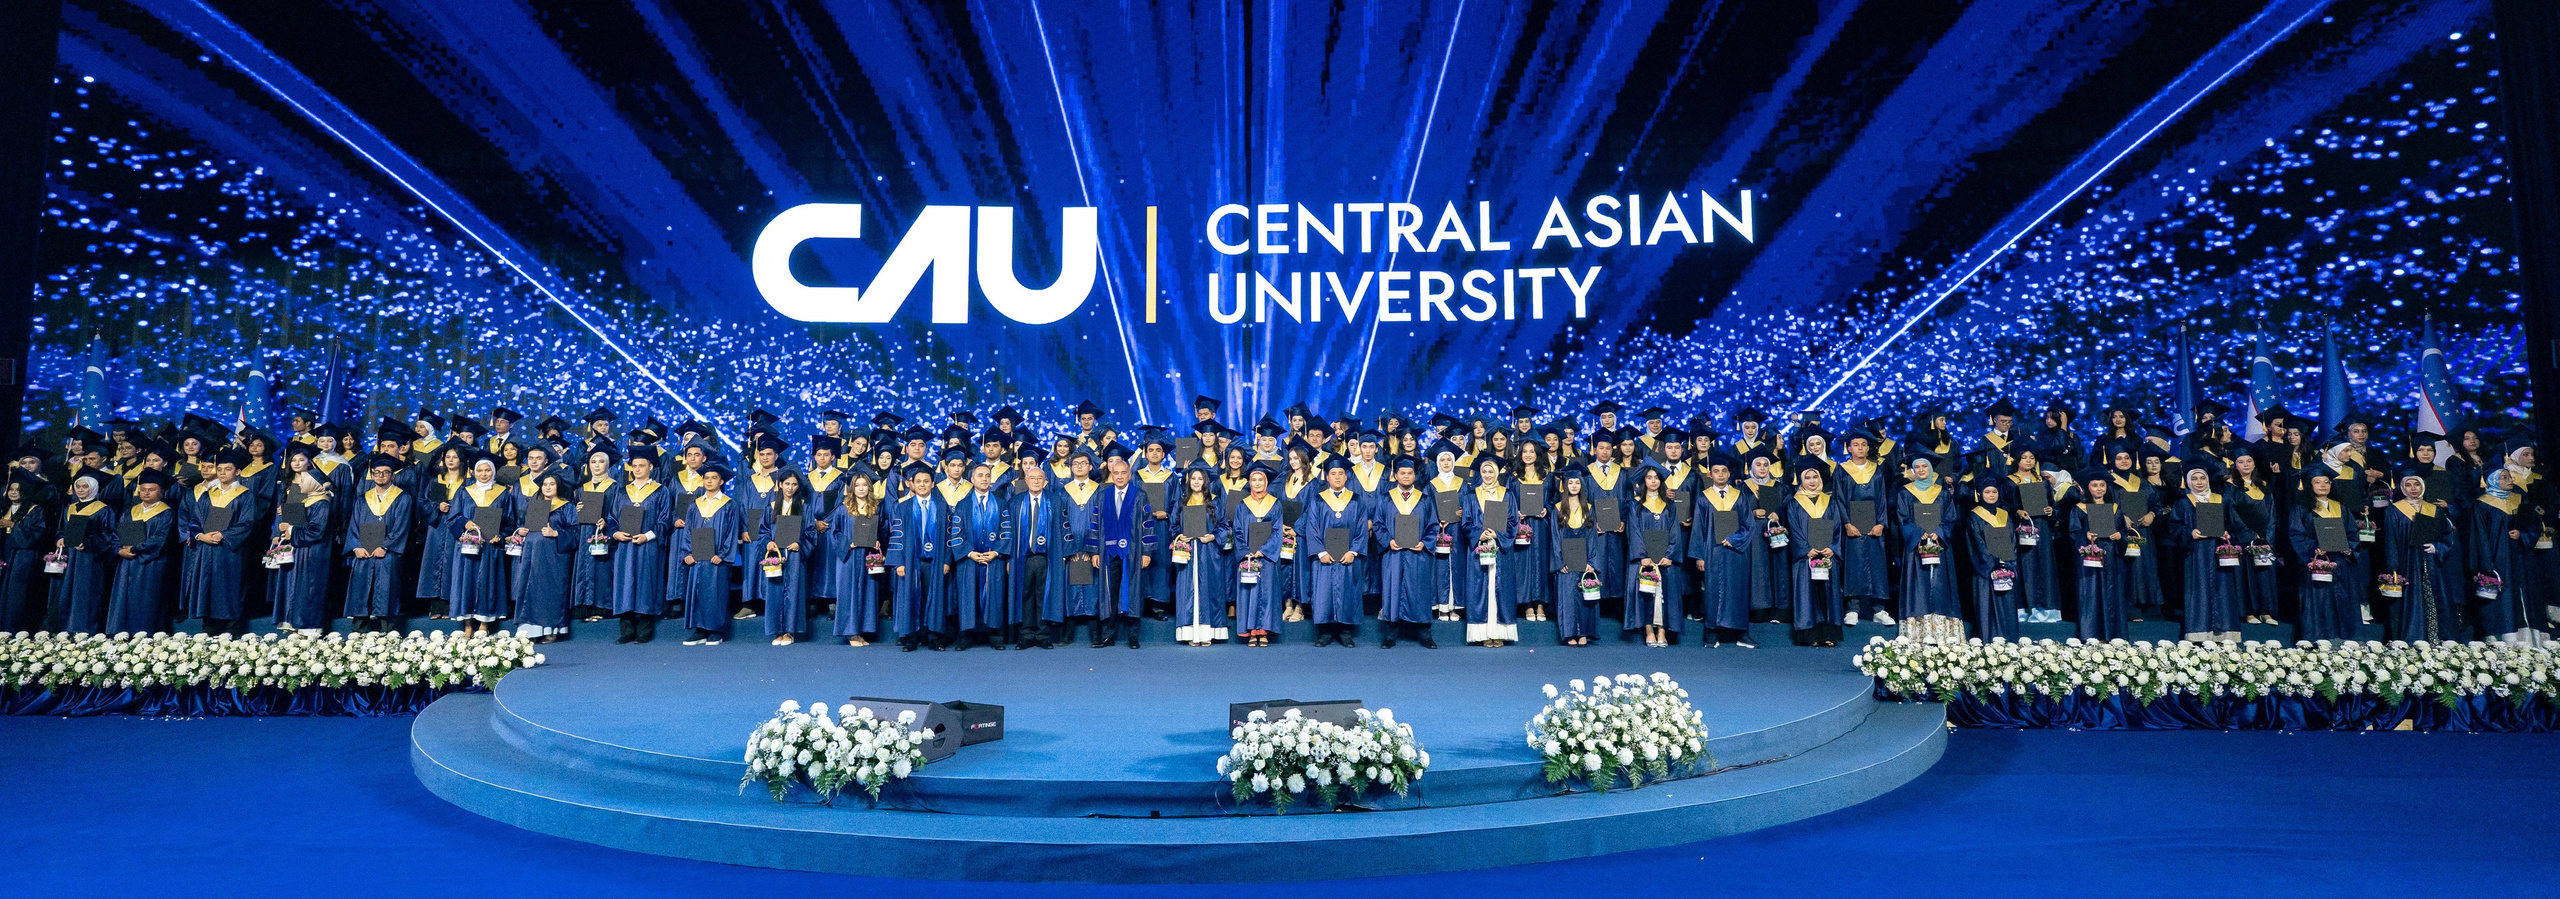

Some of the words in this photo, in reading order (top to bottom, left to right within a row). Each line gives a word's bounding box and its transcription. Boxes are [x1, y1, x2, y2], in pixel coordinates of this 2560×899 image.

[1206, 200, 1510, 255] CENTRAL
[1531, 189, 1754, 249] ASIAN
[752, 203, 1097, 324] CAU
[1208, 266, 1602, 324] UNIVERSITY
